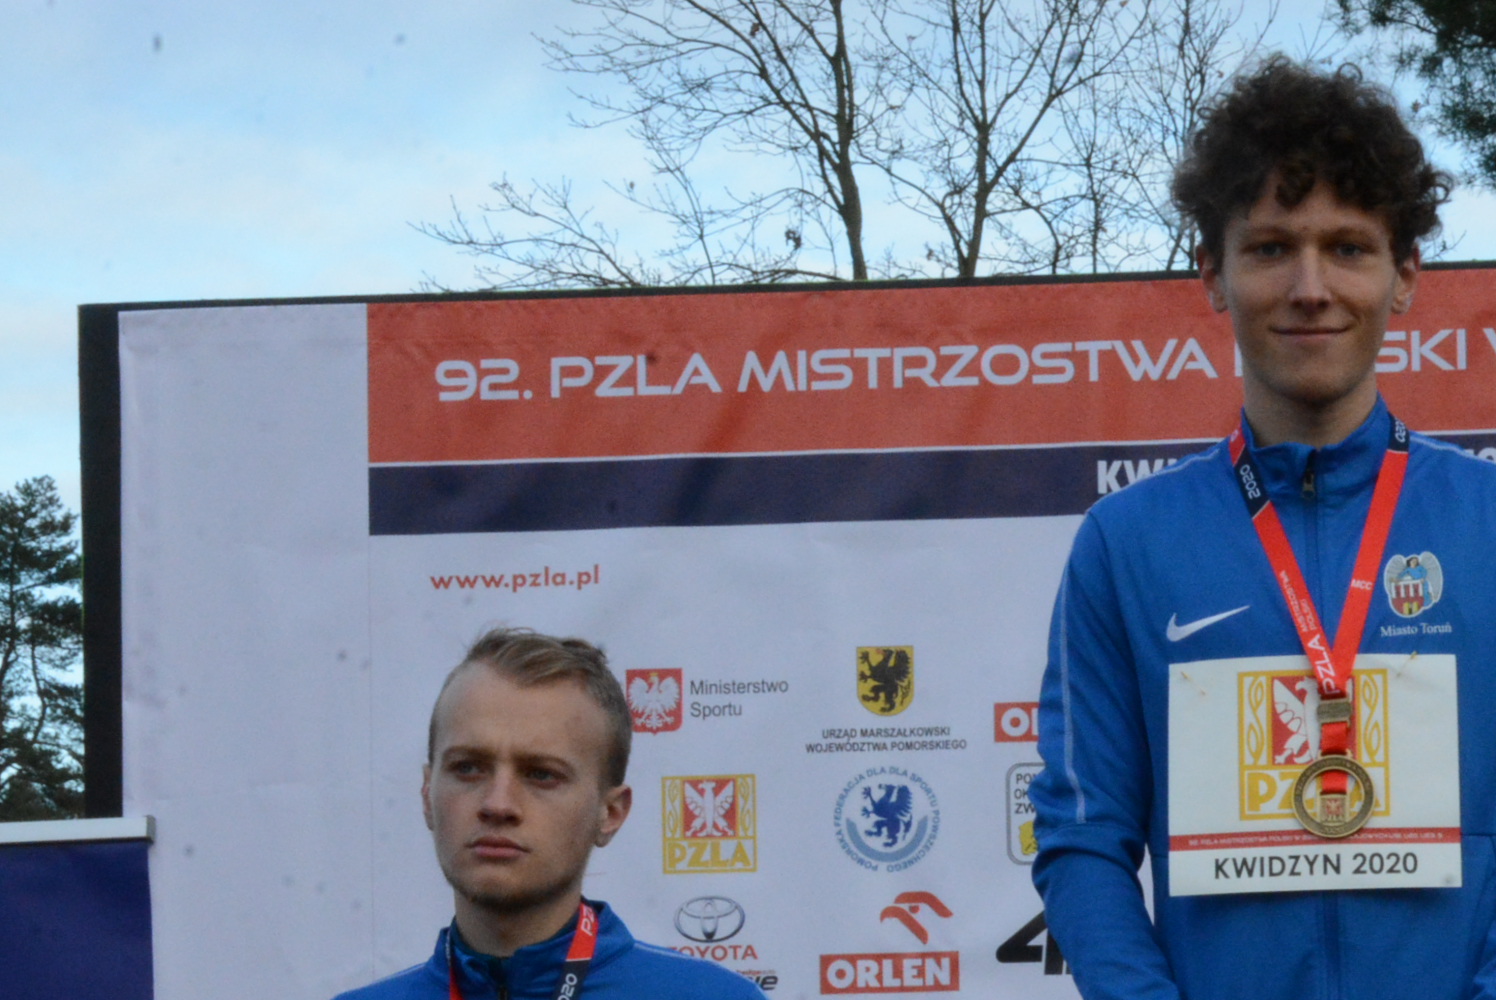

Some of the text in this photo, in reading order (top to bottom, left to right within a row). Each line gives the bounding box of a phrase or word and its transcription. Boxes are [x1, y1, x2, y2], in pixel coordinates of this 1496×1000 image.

[435, 358, 533, 402] 92.
[550, 352, 721, 399] PZLA
[738, 337, 1217, 394] MISTRZOSTWA
[430, 563, 600, 593] www.pzla.pl
[1380, 622, 1452, 637] Miasto Toruń
[1309, 634, 1341, 694] PZLA
[690, 679, 789, 696] Ministerstwo
[690, 702, 742, 718] Sportu
[890, 738, 967, 751] POMORSKIEGO
[667, 838, 746, 869] PZLA
[1215, 852, 1418, 879] KWIDZYN 2020
[668, 945, 758, 962] OYOTA
[826, 956, 951, 990] ORLEN
